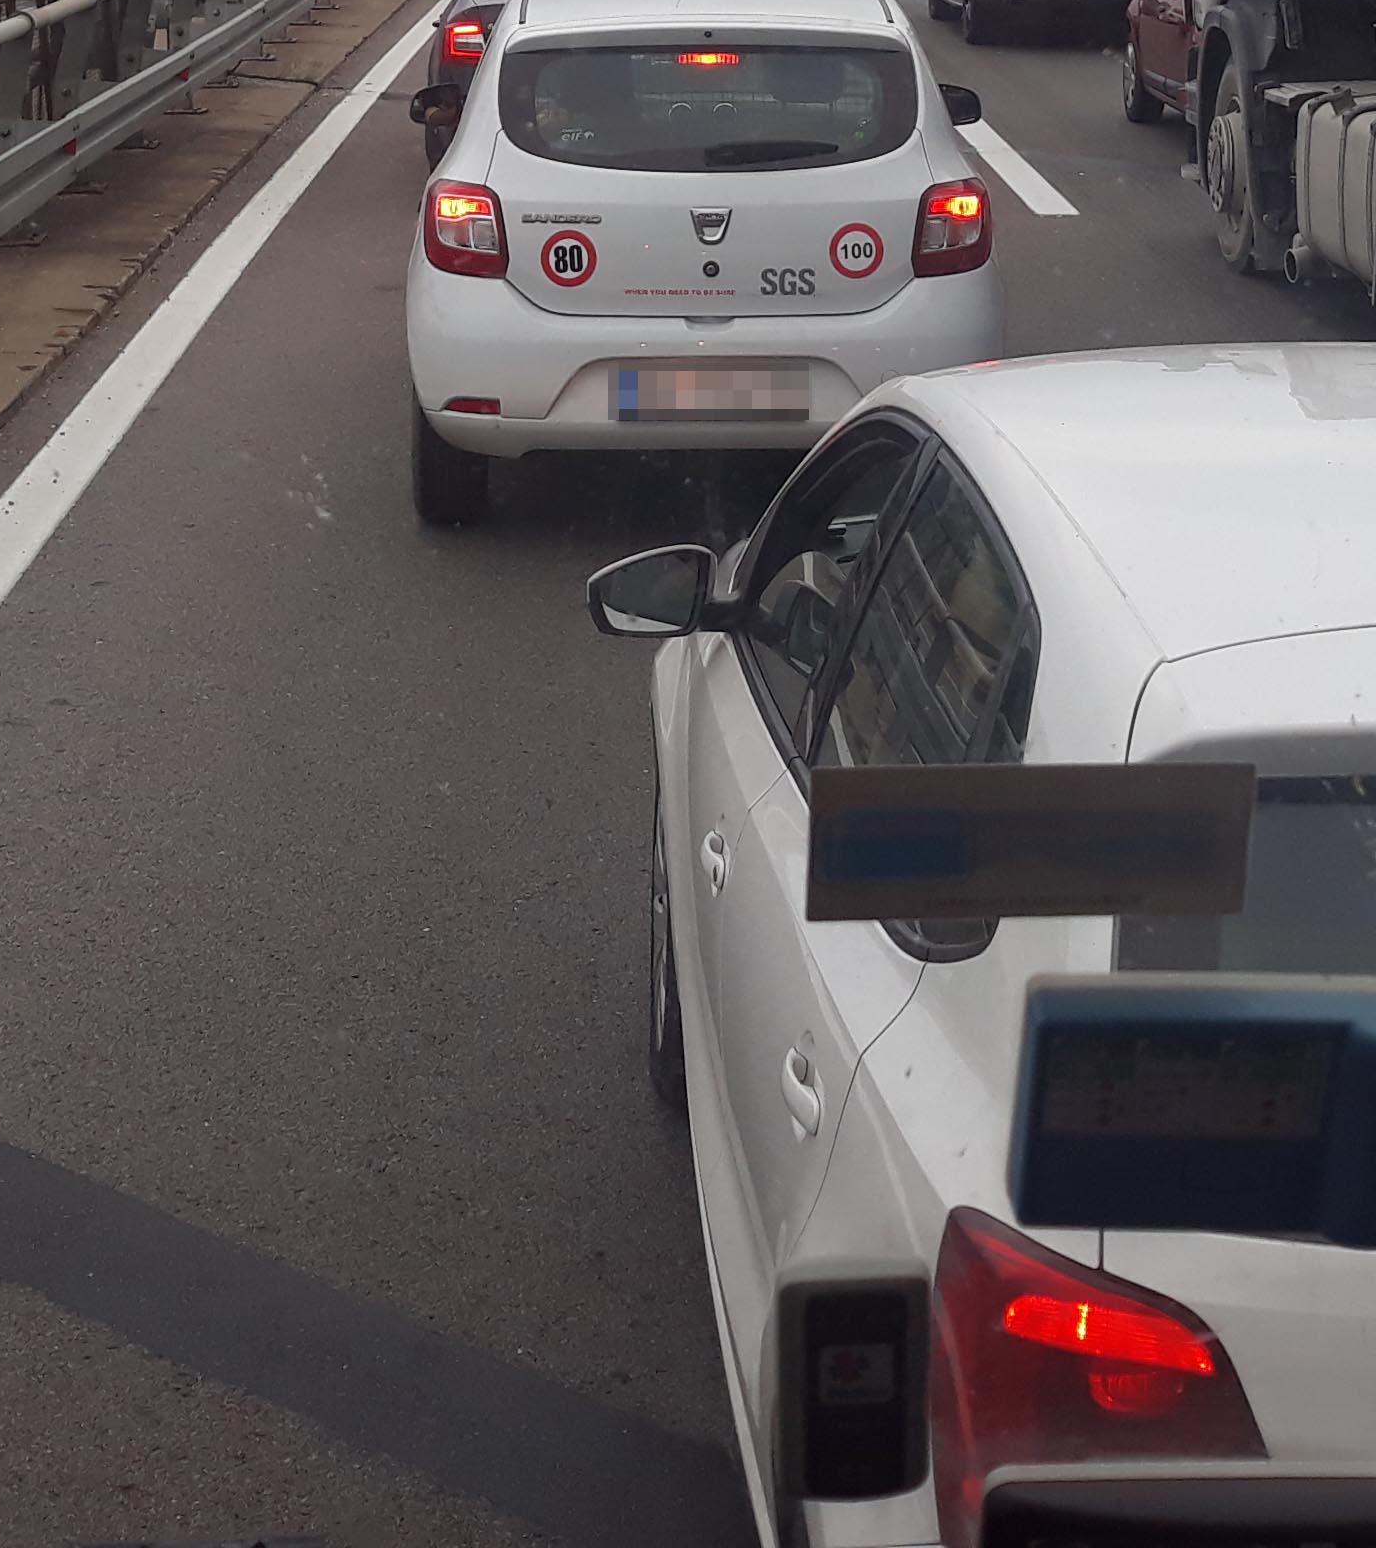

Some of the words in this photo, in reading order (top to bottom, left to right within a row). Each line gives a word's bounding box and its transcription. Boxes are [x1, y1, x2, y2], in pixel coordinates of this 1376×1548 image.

[553, 244, 583, 274] 80
[840, 242, 873, 260] 100
[760, 267, 816, 296] SGS
